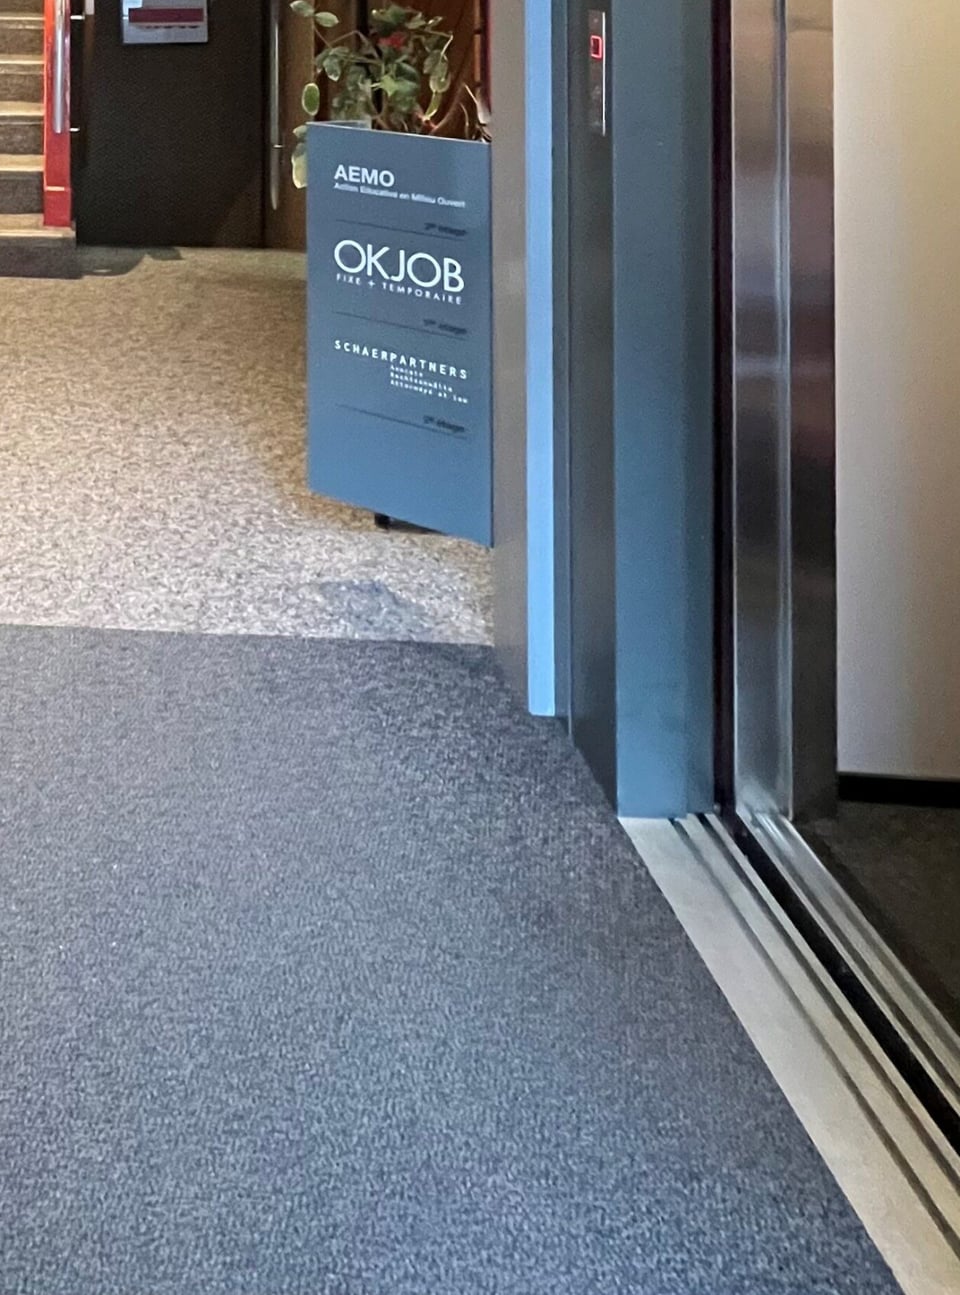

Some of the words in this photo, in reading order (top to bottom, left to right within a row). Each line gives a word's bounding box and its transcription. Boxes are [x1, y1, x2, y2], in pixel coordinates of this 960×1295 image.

[334, 164, 395, 187] AEMO
[334, 239, 465, 292] OKJOB
[336, 272, 361, 286] FIXE
[382, 281, 462, 305] TEMPORAIRE
[334, 339, 467, 380] SCHAERPARTNERS
